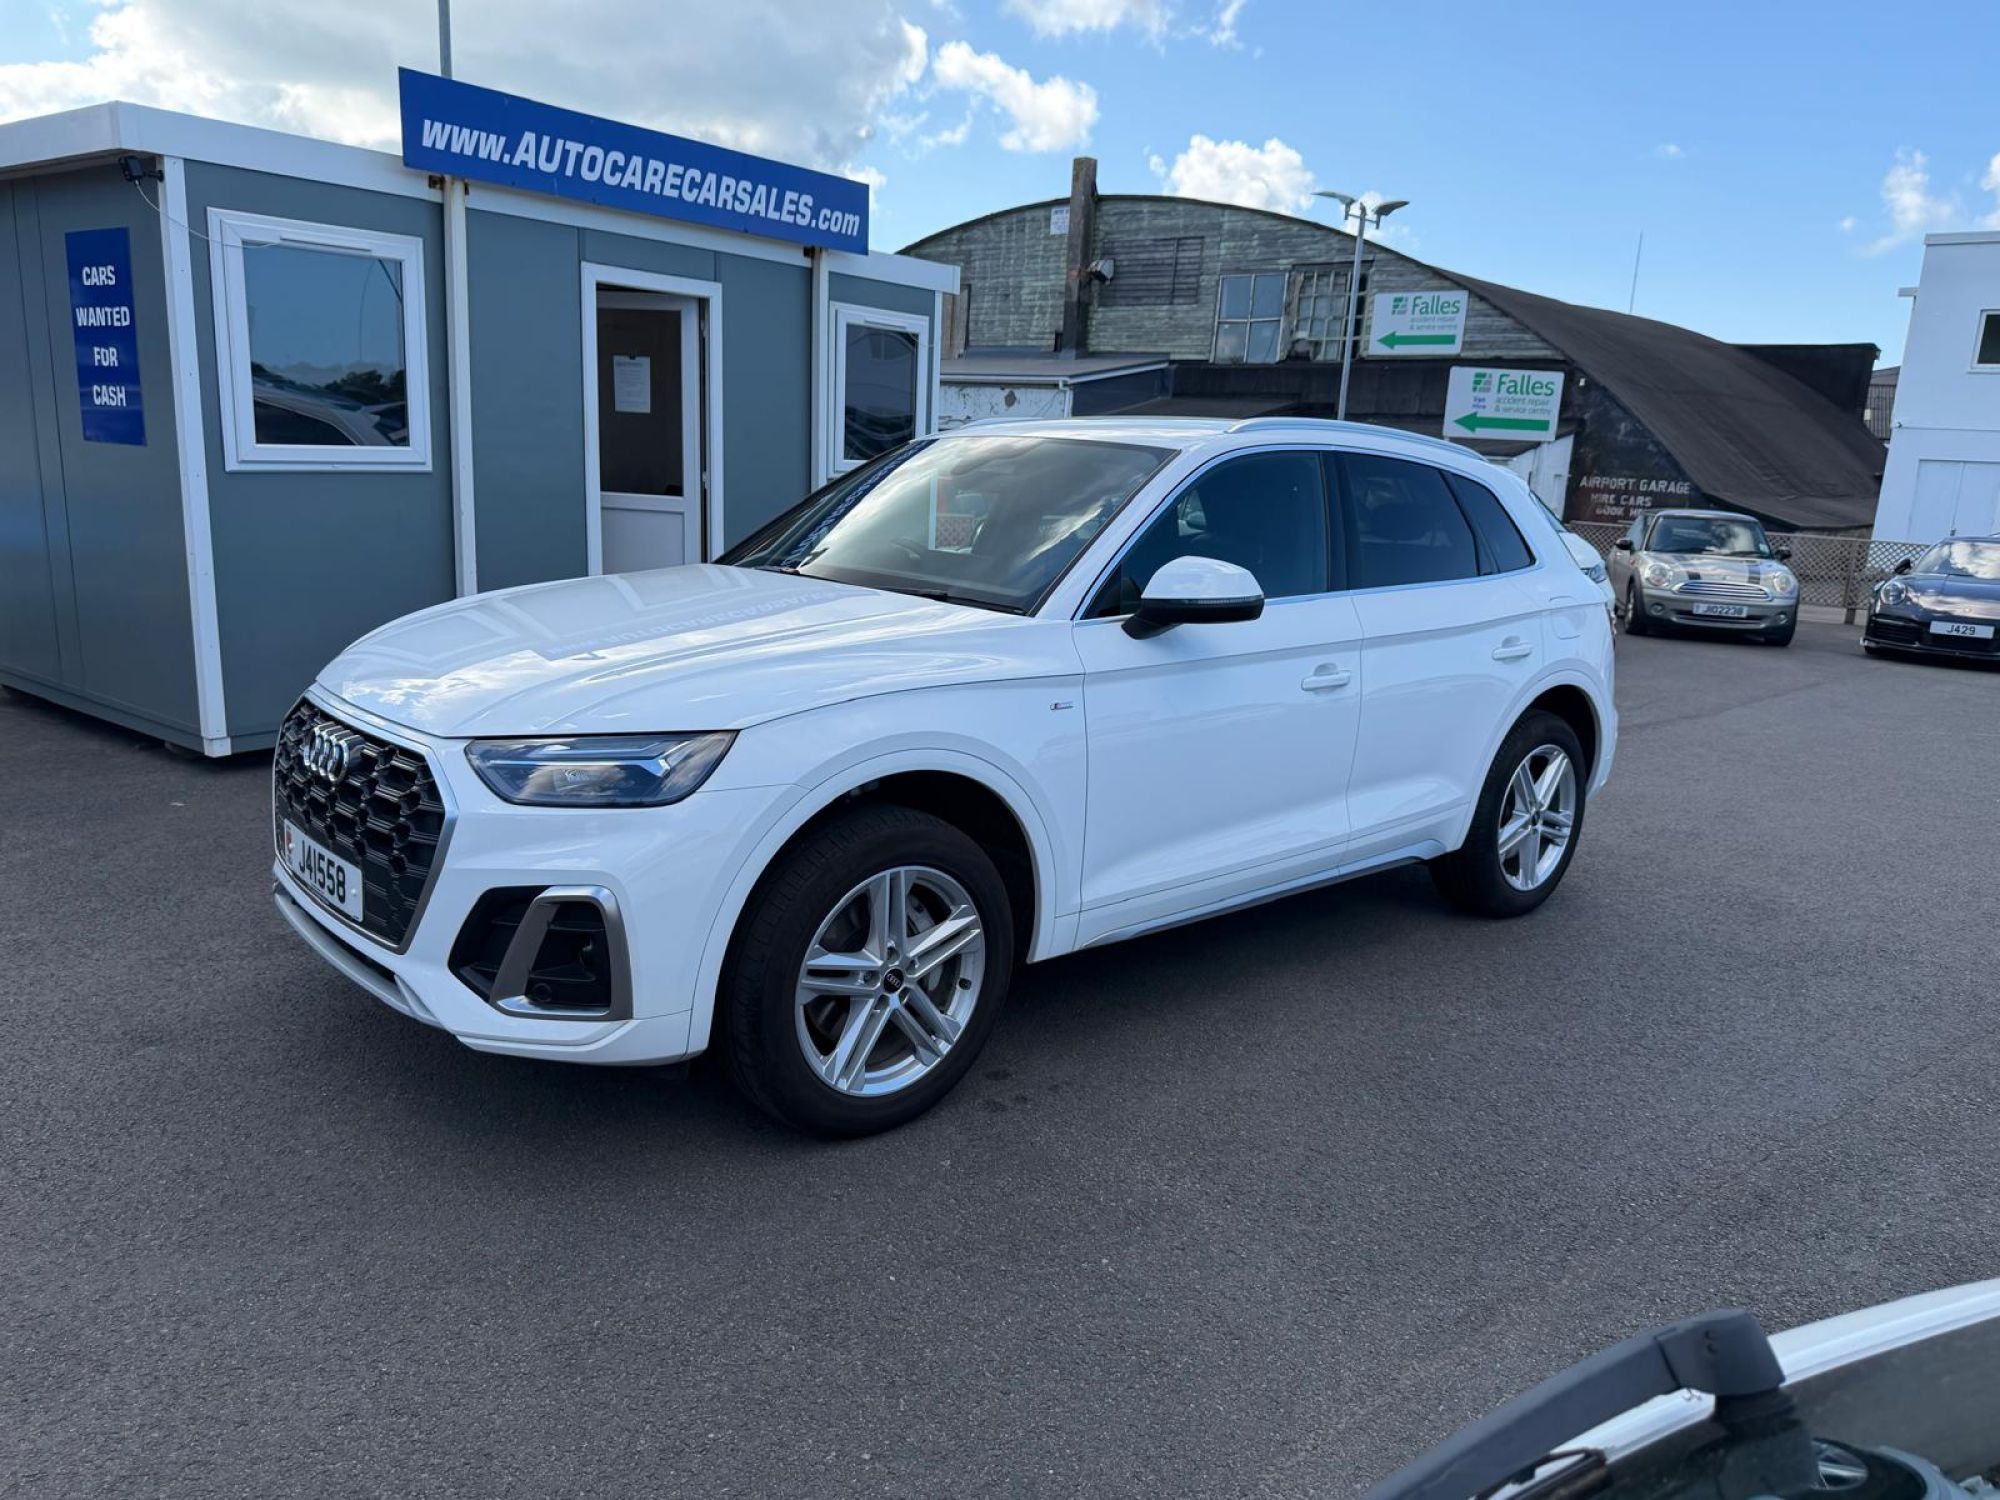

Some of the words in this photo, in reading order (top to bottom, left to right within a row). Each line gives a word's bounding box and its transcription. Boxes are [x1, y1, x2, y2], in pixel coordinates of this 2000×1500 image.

[82, 264, 116, 286] CARS
[1411, 295, 1460, 315] Falles
[75, 306, 131, 327] WANTED
[93, 347, 119, 367] FOR
[1497, 373, 1555, 396] Falles
[93, 385, 127, 407] CASH
[1580, 475, 1636, 490] AIRPORT
[1639, 480, 1690, 494] GARAGE
[1620, 494, 1653, 507] CARS
[1946, 624, 1976, 636] J429
[298, 839, 346, 904] J41558
